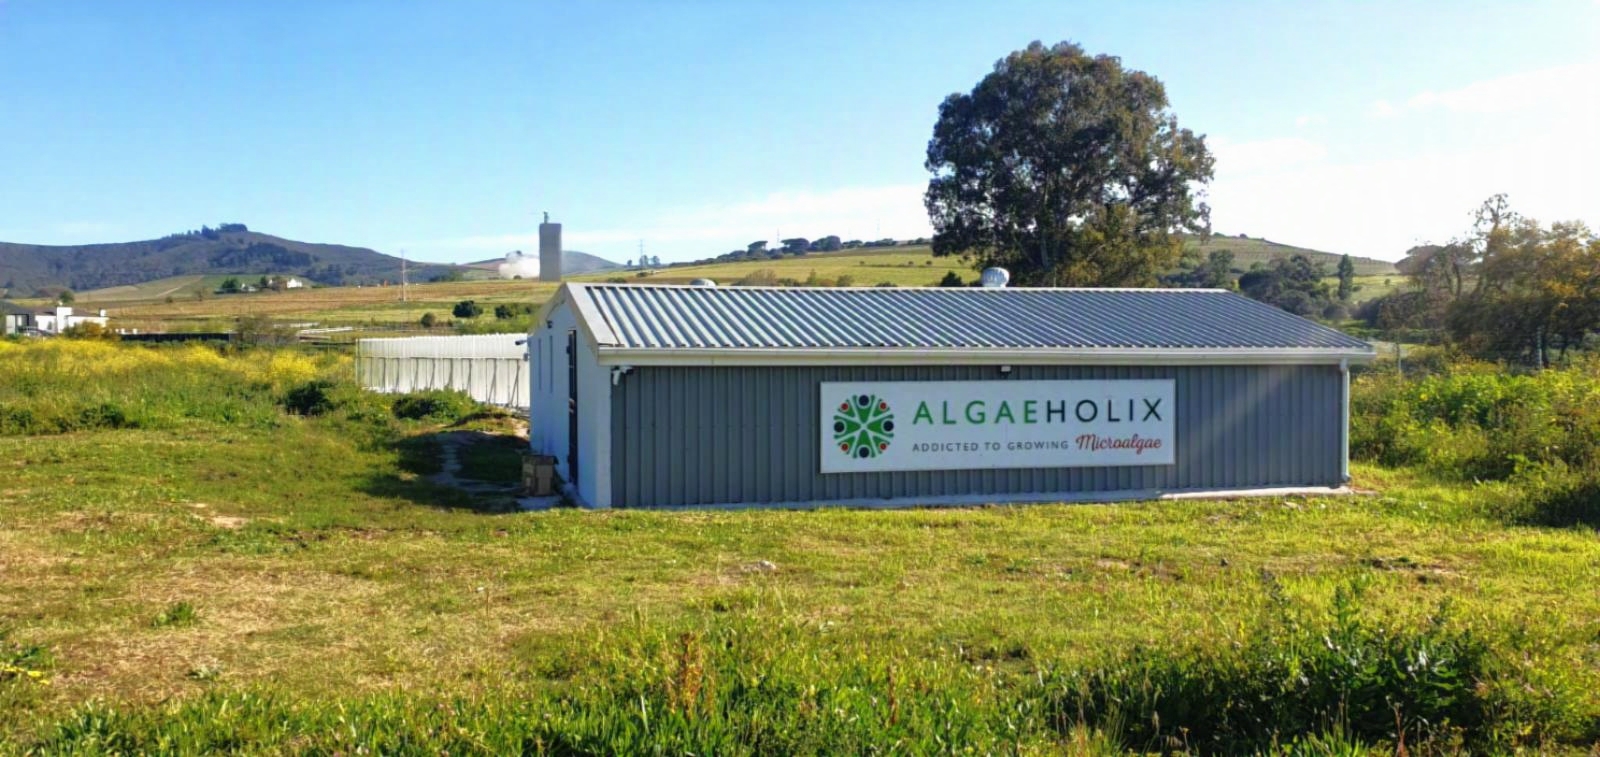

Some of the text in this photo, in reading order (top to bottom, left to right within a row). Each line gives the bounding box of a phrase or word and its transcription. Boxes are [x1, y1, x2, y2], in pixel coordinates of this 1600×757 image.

[912, 398, 1163, 425] ALGAEHOLIX
[912, 433, 1162, 455] ADDICTED TO GROWING Microalgae
